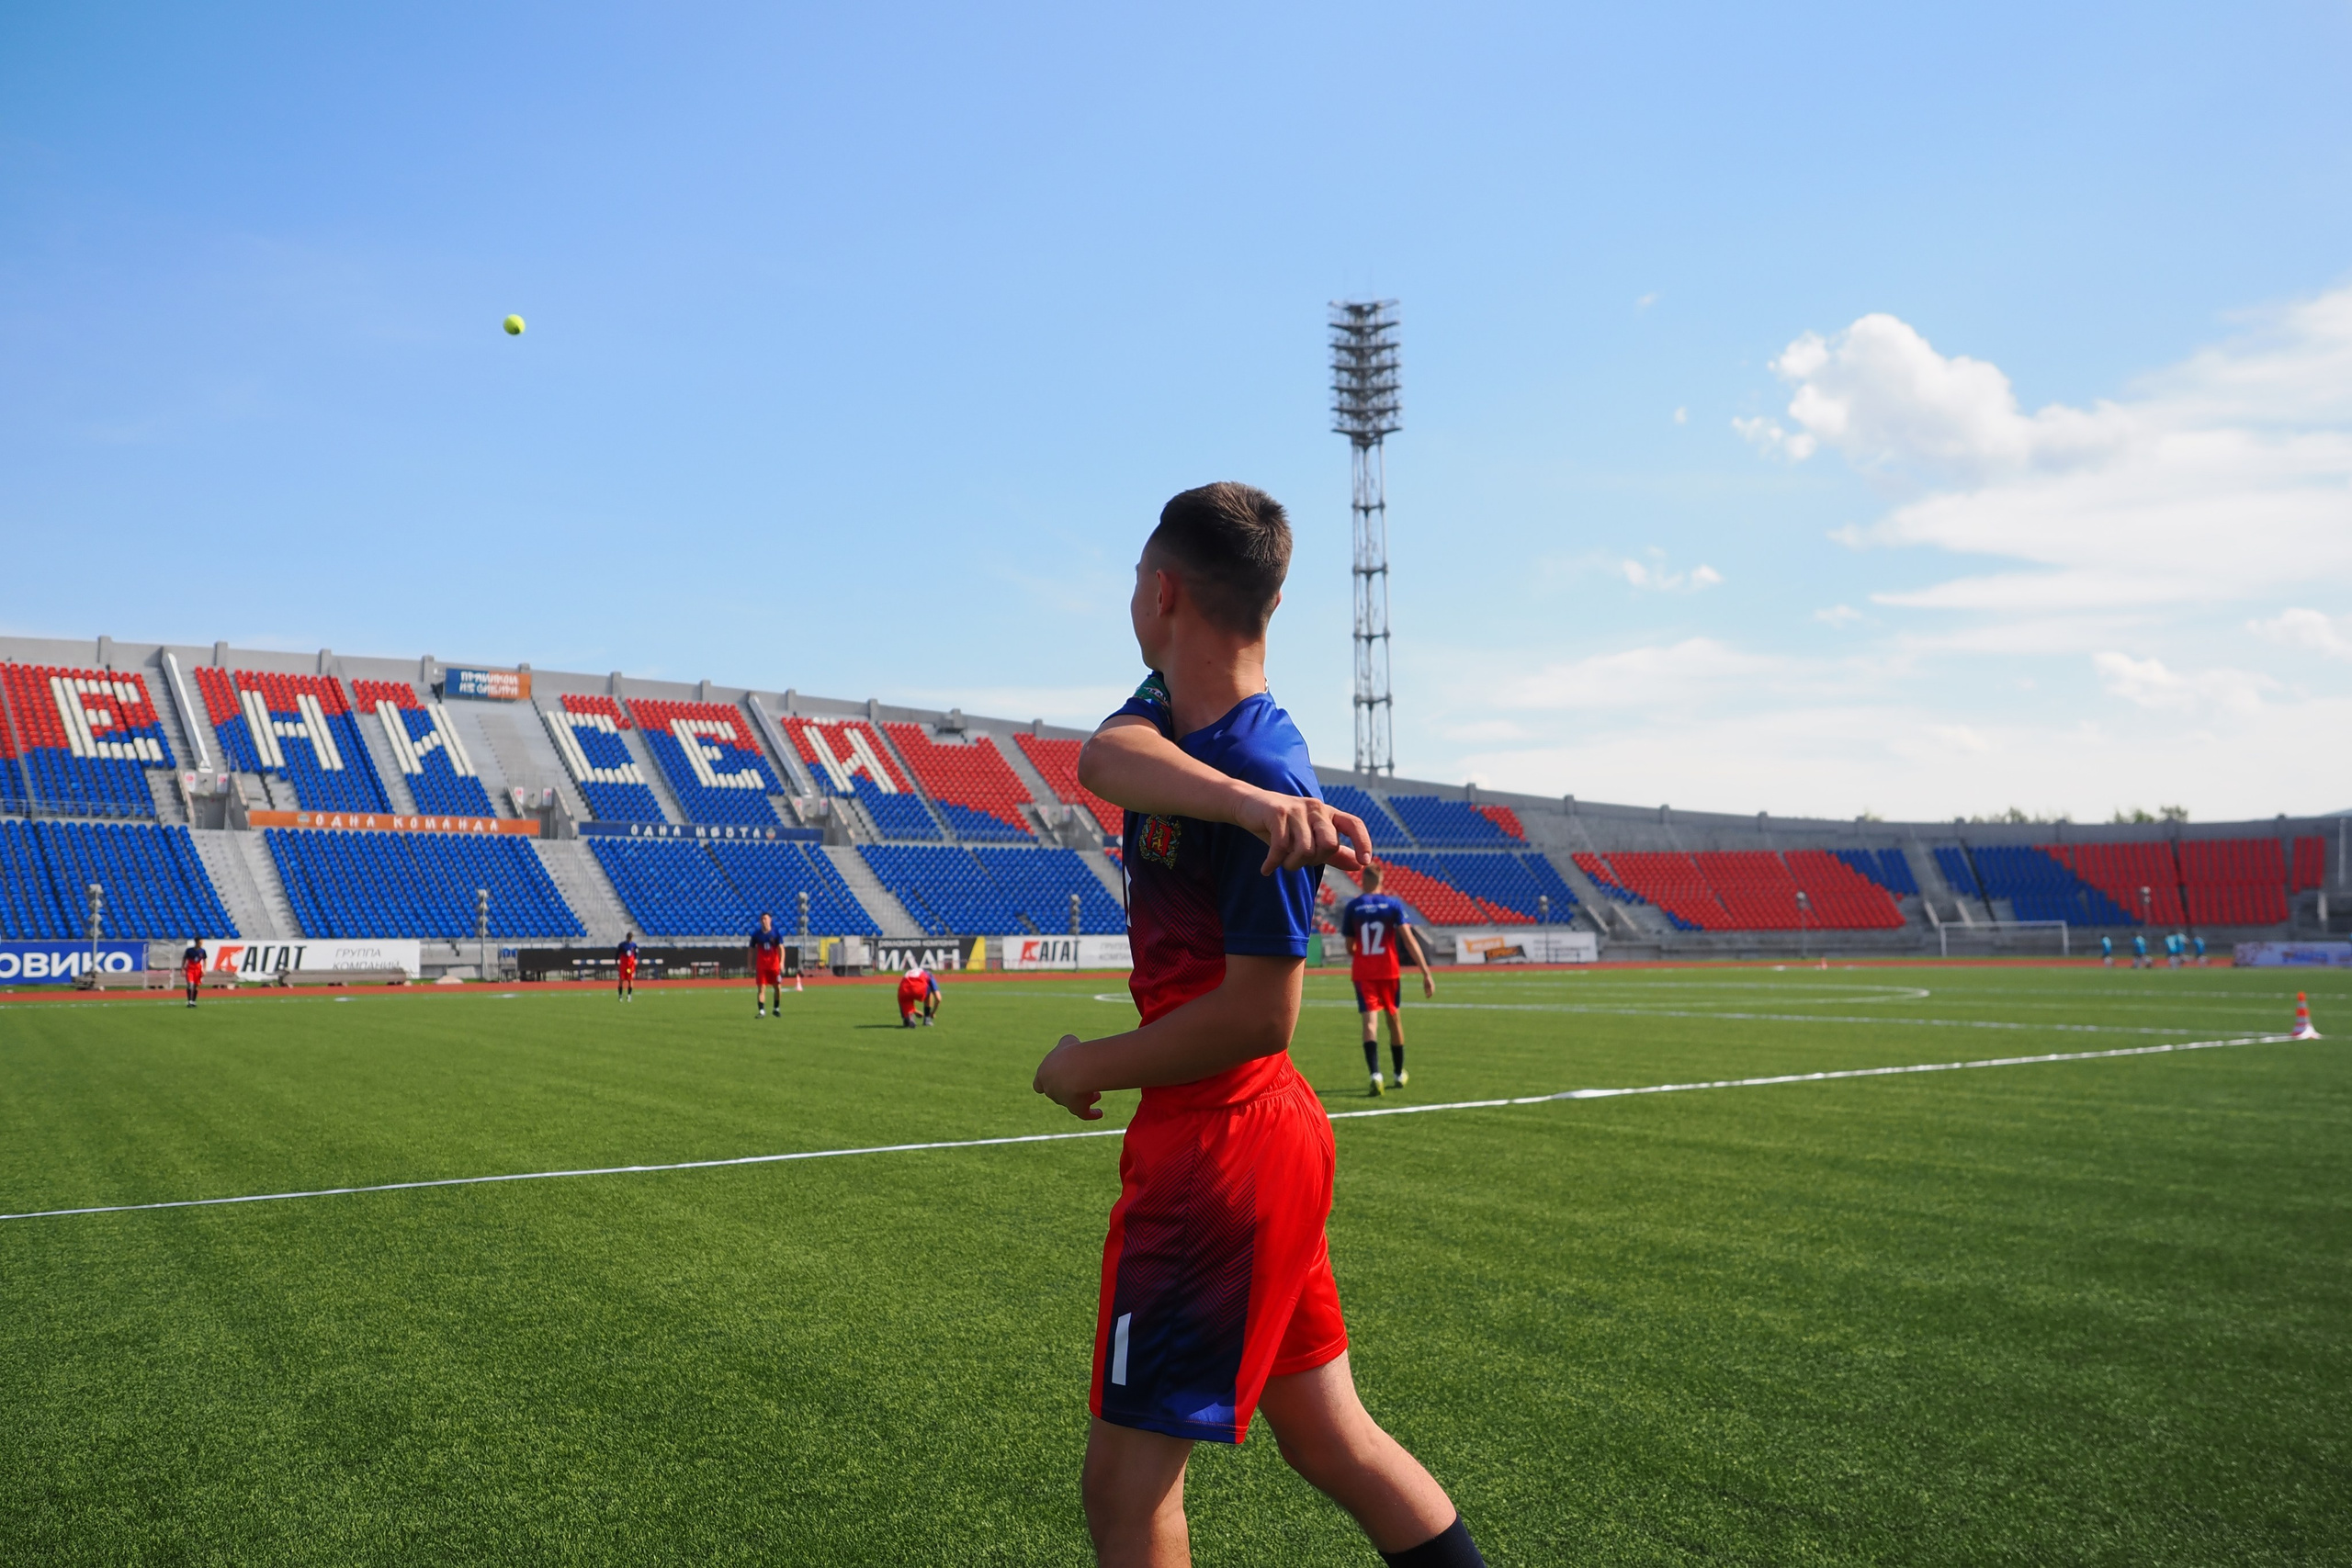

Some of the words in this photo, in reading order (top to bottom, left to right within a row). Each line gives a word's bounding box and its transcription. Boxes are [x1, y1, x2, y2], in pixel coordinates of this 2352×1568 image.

[315, 814, 376, 829] ОДНА
[393, 816, 498, 832] КОМАНДА
[630, 823, 681, 838] ОДНА
[1361, 921, 1385, 955] 12
[241, 945, 307, 974] АГАТ
[335, 948, 381, 958] ГРУППА
[878, 949, 961, 971] ИЛАН
[1039, 941, 1080, 963] АГАТ
